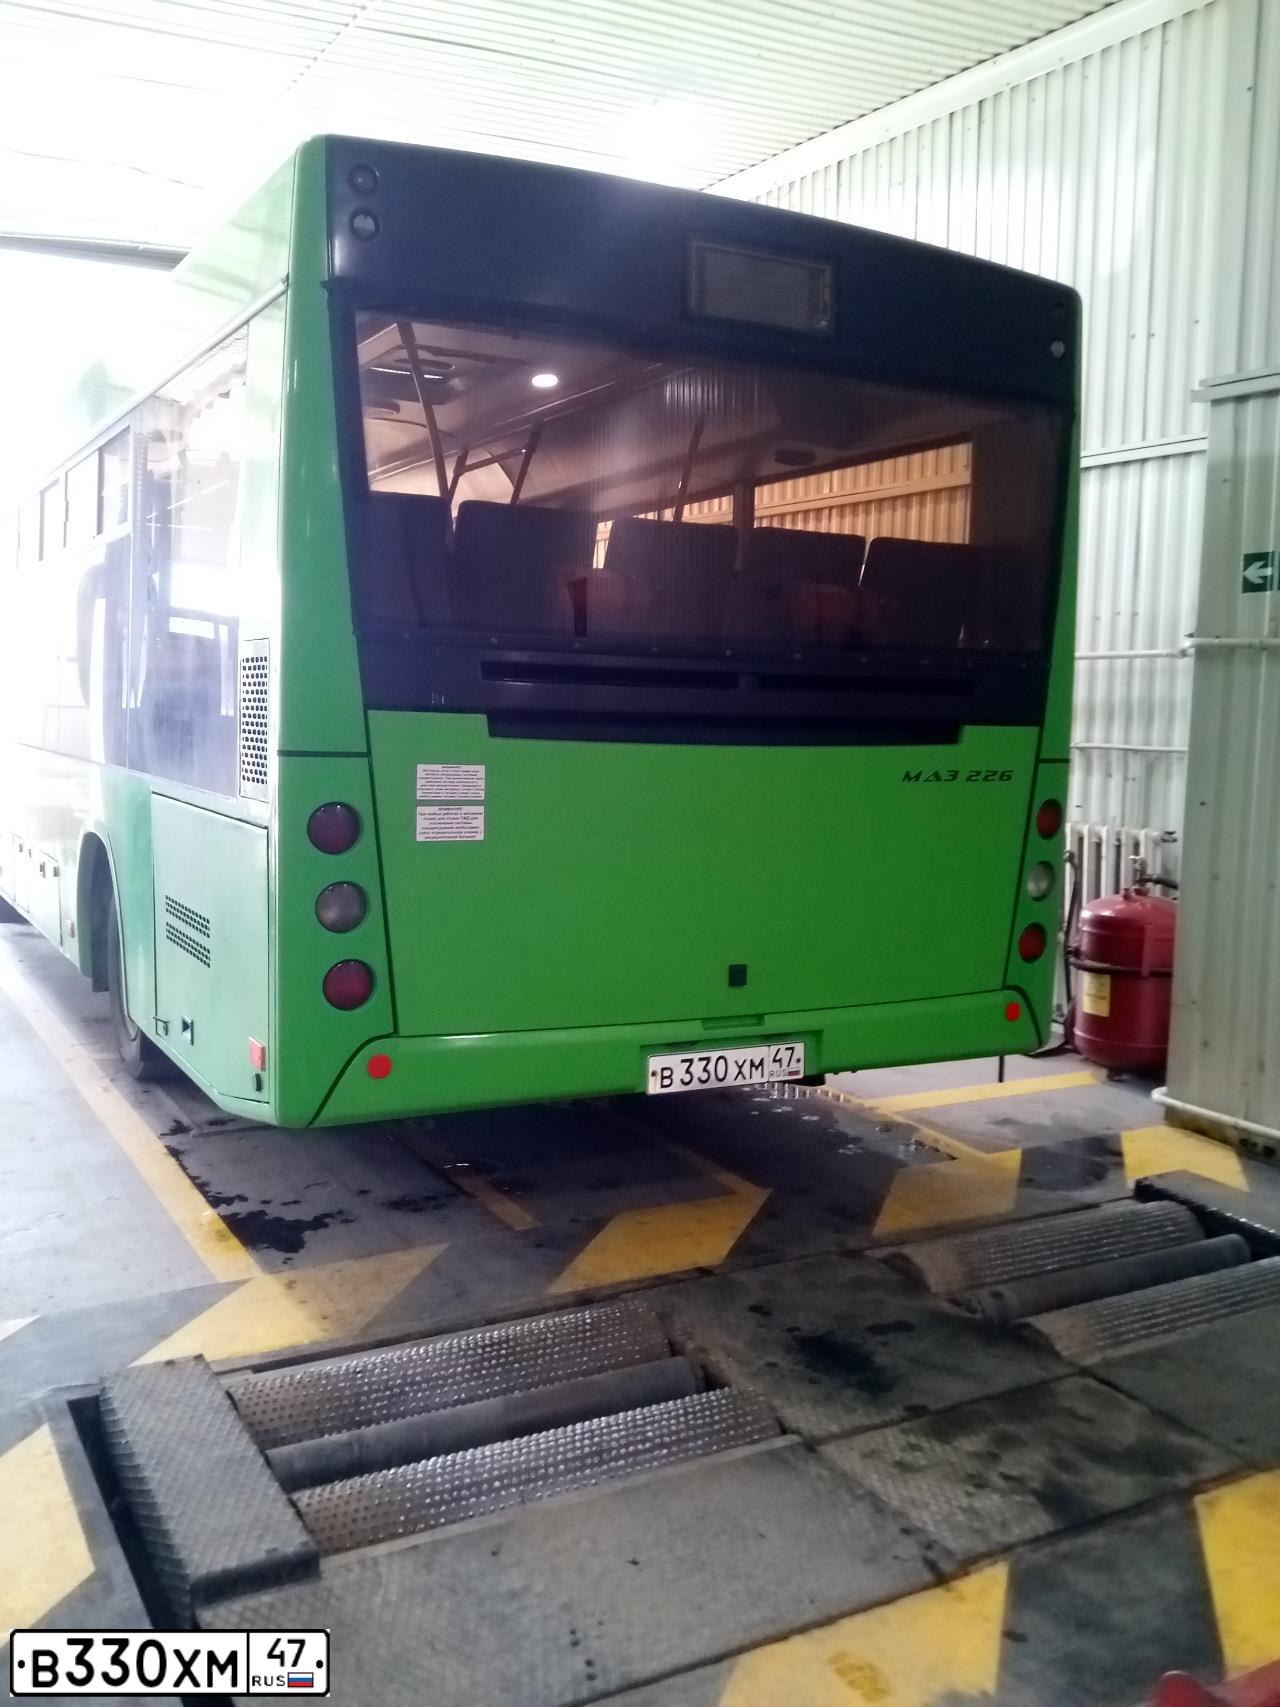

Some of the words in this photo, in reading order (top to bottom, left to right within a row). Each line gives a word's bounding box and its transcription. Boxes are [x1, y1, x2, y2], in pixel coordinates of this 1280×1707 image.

[902, 769, 960, 782] МАЗ
[965, 769, 1014, 782] 226
[772, 1047, 796, 1068] 47
[769, 1068, 788, 1078] RUS
